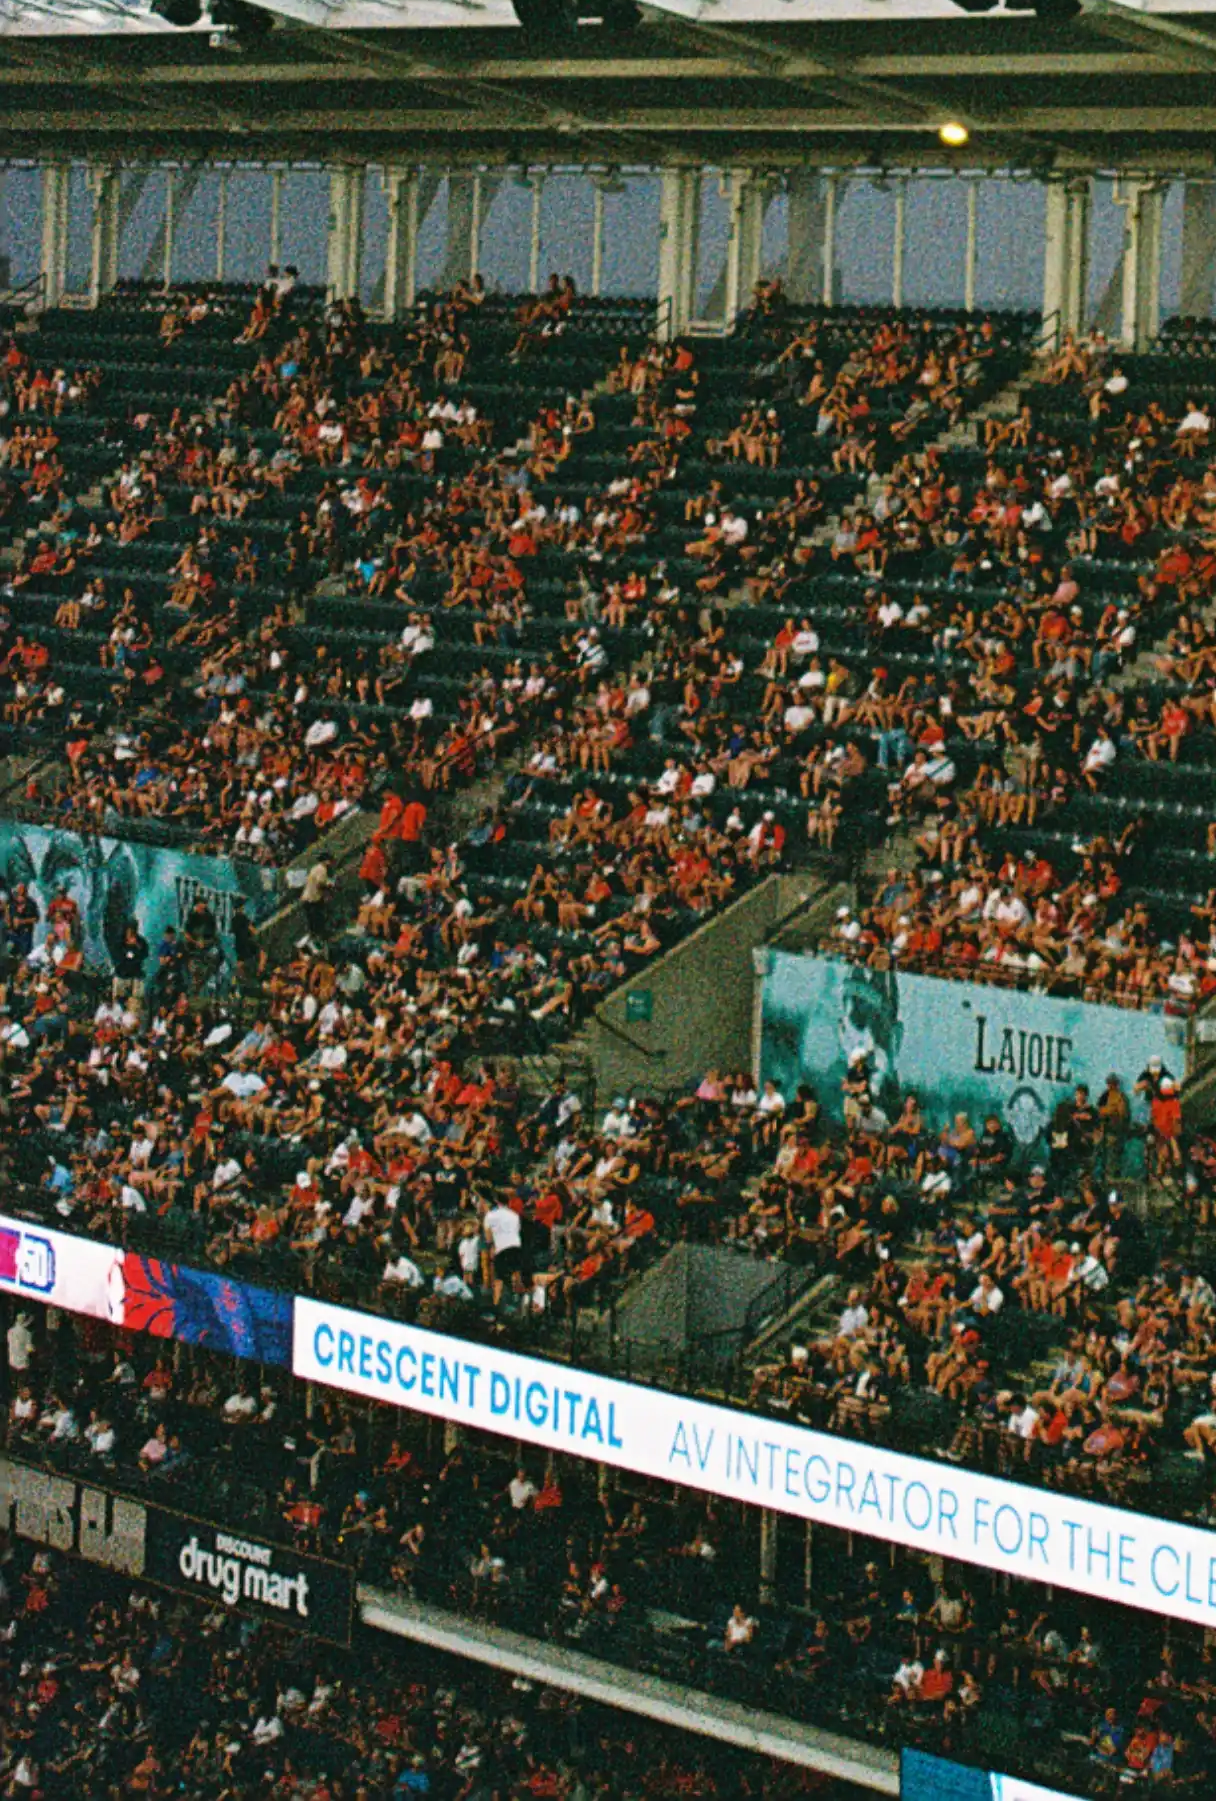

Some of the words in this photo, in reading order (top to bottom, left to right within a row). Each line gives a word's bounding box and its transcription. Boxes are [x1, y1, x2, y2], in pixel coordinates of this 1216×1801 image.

[974, 1015, 1073, 1082] LAJOIE
[312, 1322, 482, 1410] CRESCENT
[489, 1369, 624, 1450] DIGITAL
[668, 1419, 713, 1473] AV
[725, 1434, 959, 1538] INTEGRATOR
[972, 1496, 1050, 1563] FOR
[1062, 1519, 1137, 1588] THE
[180, 1536, 240, 1605] drug
[243, 1564, 310, 1618] mart
